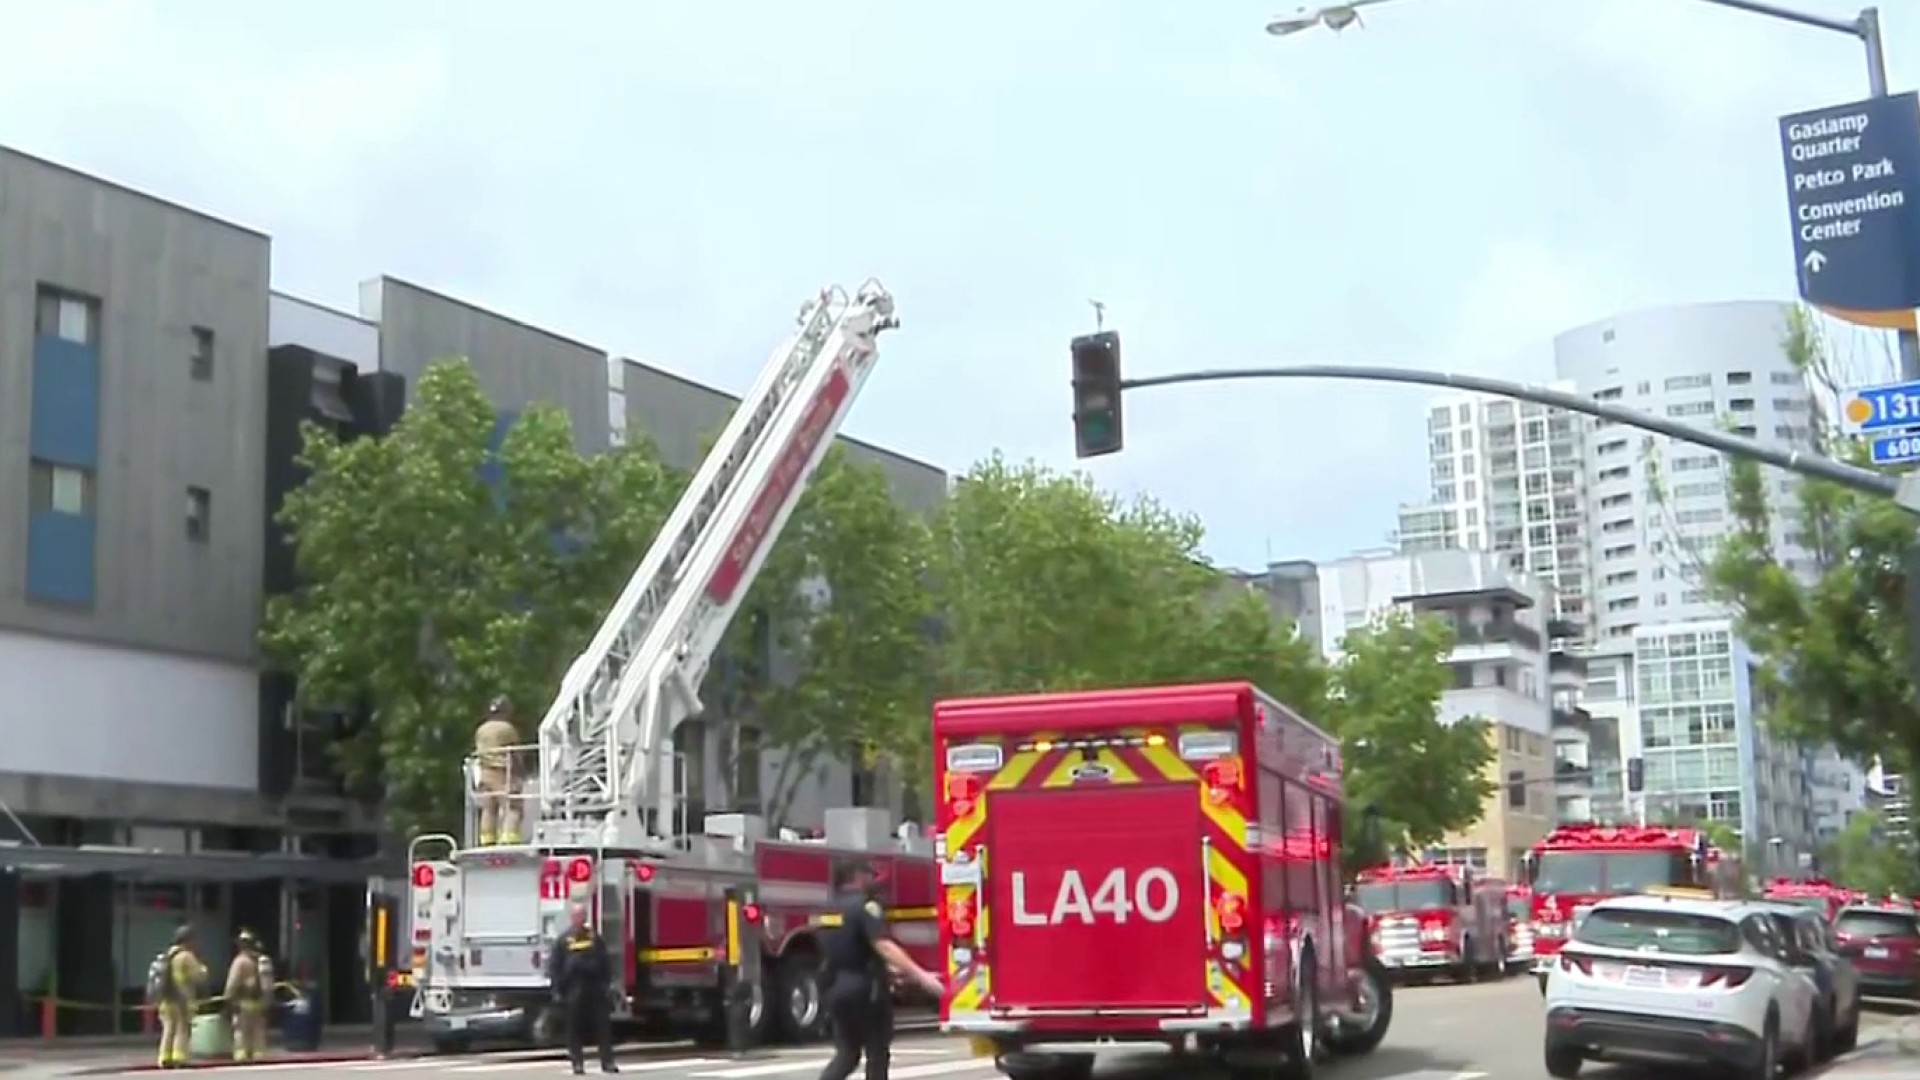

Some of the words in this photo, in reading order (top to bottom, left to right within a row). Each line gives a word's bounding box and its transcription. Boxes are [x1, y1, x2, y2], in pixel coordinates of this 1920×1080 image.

[1789, 114, 1869, 141] Gaslamp
[1791, 135, 1861, 161] Quarter
[1794, 169, 1845, 191] Petco
[1852, 157, 1895, 181] Park
[1798, 190, 1904, 220] Convention
[1801, 219, 1861, 242] Center
[1011, 867, 1180, 926] LA40
